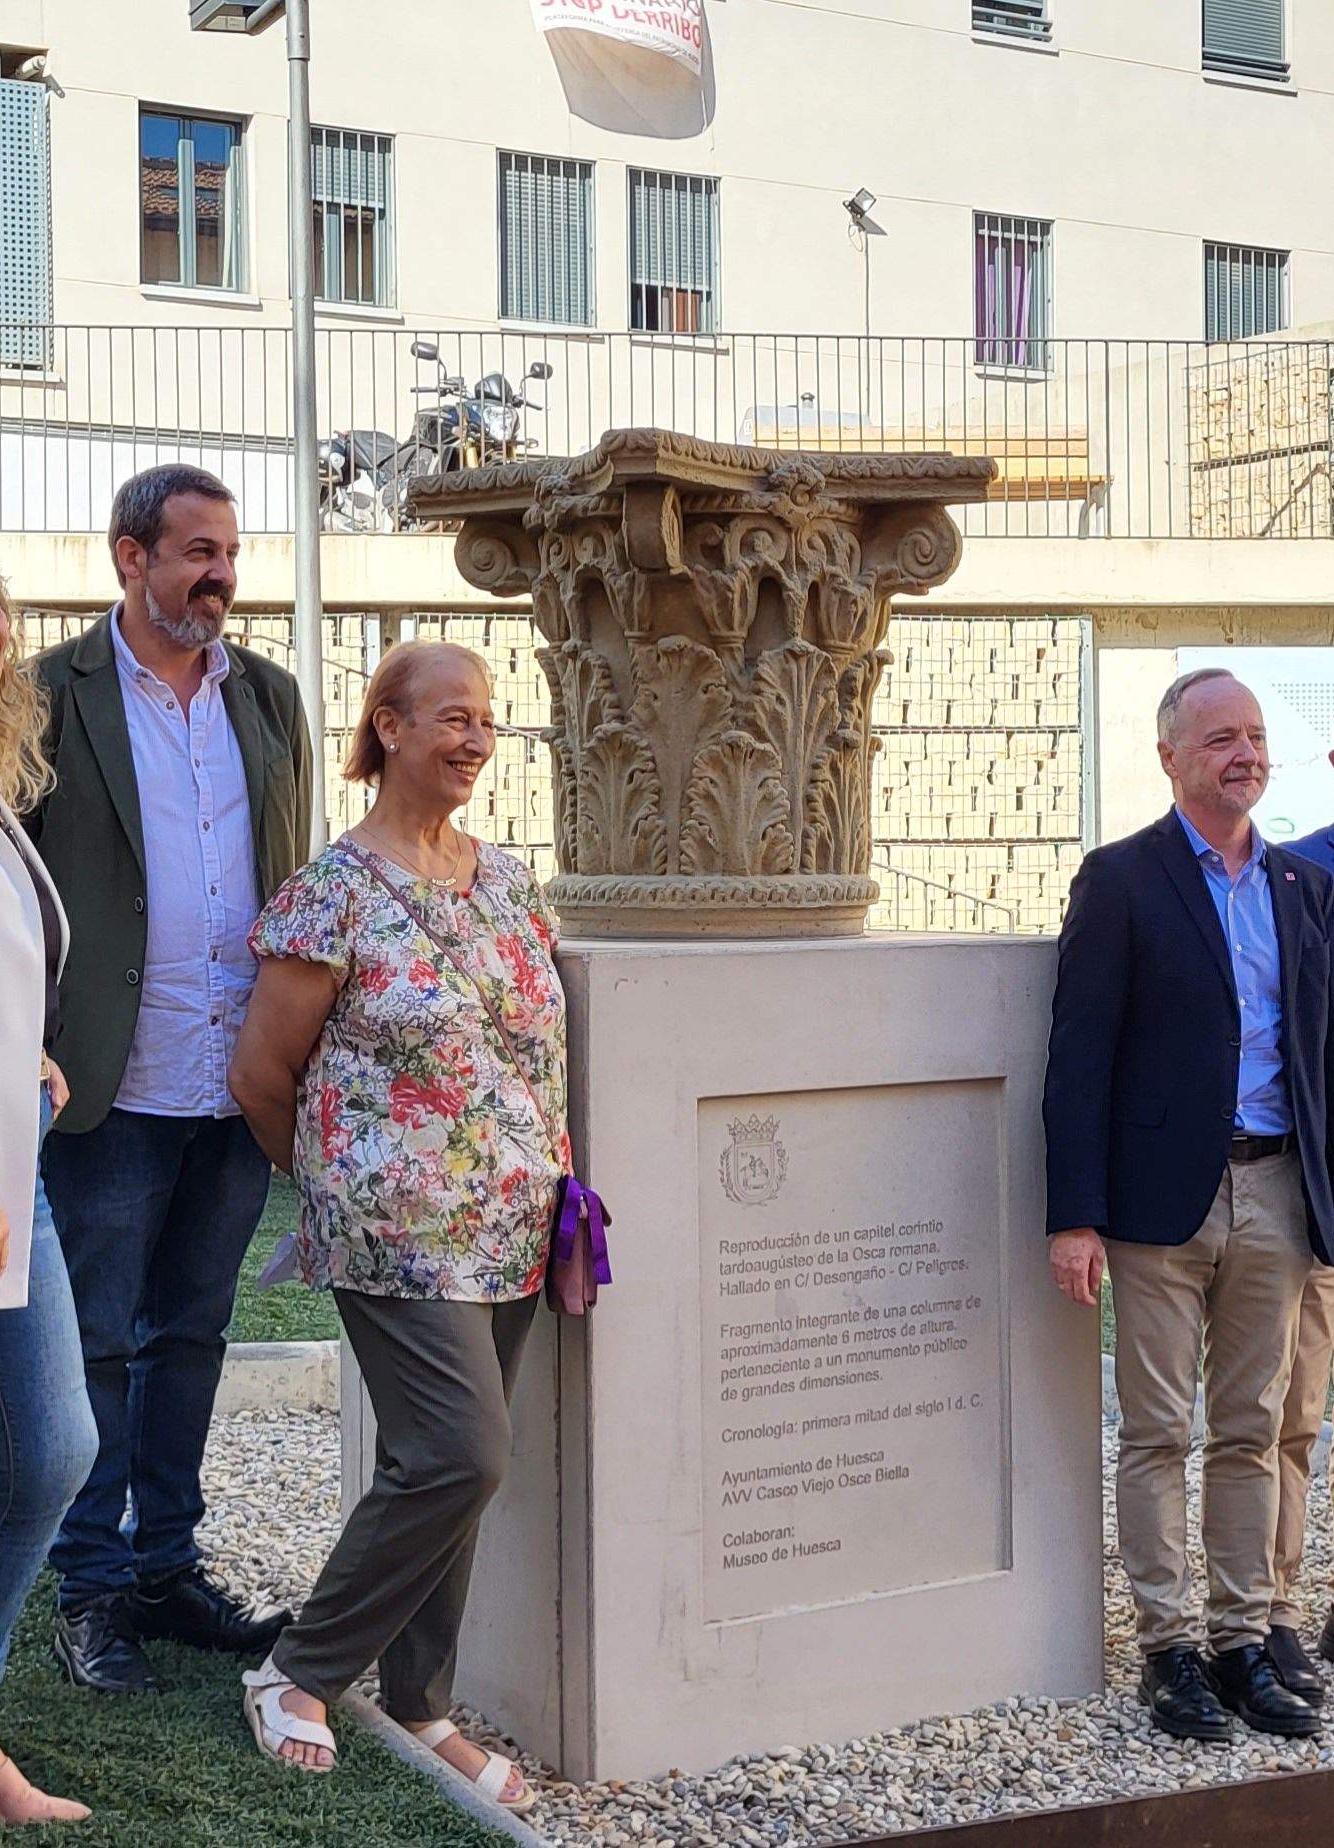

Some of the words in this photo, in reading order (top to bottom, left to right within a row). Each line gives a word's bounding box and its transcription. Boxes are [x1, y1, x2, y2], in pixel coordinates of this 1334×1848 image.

[719, 1232, 809, 1256] Reproducción
[814, 1231, 830, 1245] de
[834, 1230, 849, 1242] un
[854, 1222, 894, 1242] capitel
[719, 1254, 814, 1275] tardoaugústeo
[818, 1251, 833, 1264] de
[838, 1249, 848, 1262] la
[853, 1247, 885, 1260] Osca
[889, 1241, 940, 1256] romana.
[720, 1278, 770, 1296] Hallado
[774, 1278, 790, 1290] en
[795, 1273, 809, 1288] C/
[813, 1266, 885, 1286] Desengaño
[898, 1262, 913, 1276] C/
[721, 1318, 792, 1339] Fragmento
[864, 1306, 879, 1320] de
[883, 1306, 906, 1318] una
[910, 1299, 962, 1315] columna
[965, 1294, 981, 1309] de
[721, 1333, 837, 1361] aproximadamente
[841, 1330, 849, 1344] 6
[854, 1327, 896, 1343] metros
[901, 1323, 915, 1337] de
[721, 1357, 810, 1383] perteneciente
[814, 1356, 822, 1368] a
[826, 1354, 842, 1367] un
[846, 1344, 920, 1363] monumento
[924, 1337, 968, 1357] público
[721, 1387, 737, 1401] de
[742, 1380, 795, 1401] grandes
[799, 1370, 883, 1391] dimensiones.
[722, 1420, 798, 1443] Cronología:
[802, 1415, 851, 1435] primera
[855, 1406, 888, 1424] mitad
[893, 1403, 912, 1418] del
[915, 1400, 944, 1417] siglo
[955, 1396, 966, 1410] d.
[970, 1393, 983, 1407] C.
[721, 1460, 812, 1488] Ayuntamiento
[816, 1457, 832, 1471] de
[836, 1450, 884, 1468] Huesca
[722, 1488, 752, 1507] AVV
[756, 1484, 798, 1500] Casco
[801, 1477, 834, 1494] Viejo
[875, 1465, 909, 1482] Biella
[722, 1525, 795, 1548] Colaboran:
[723, 1551, 767, 1569] Museo
[771, 1547, 788, 1561] de
[792, 1539, 841, 1557] Huesca
